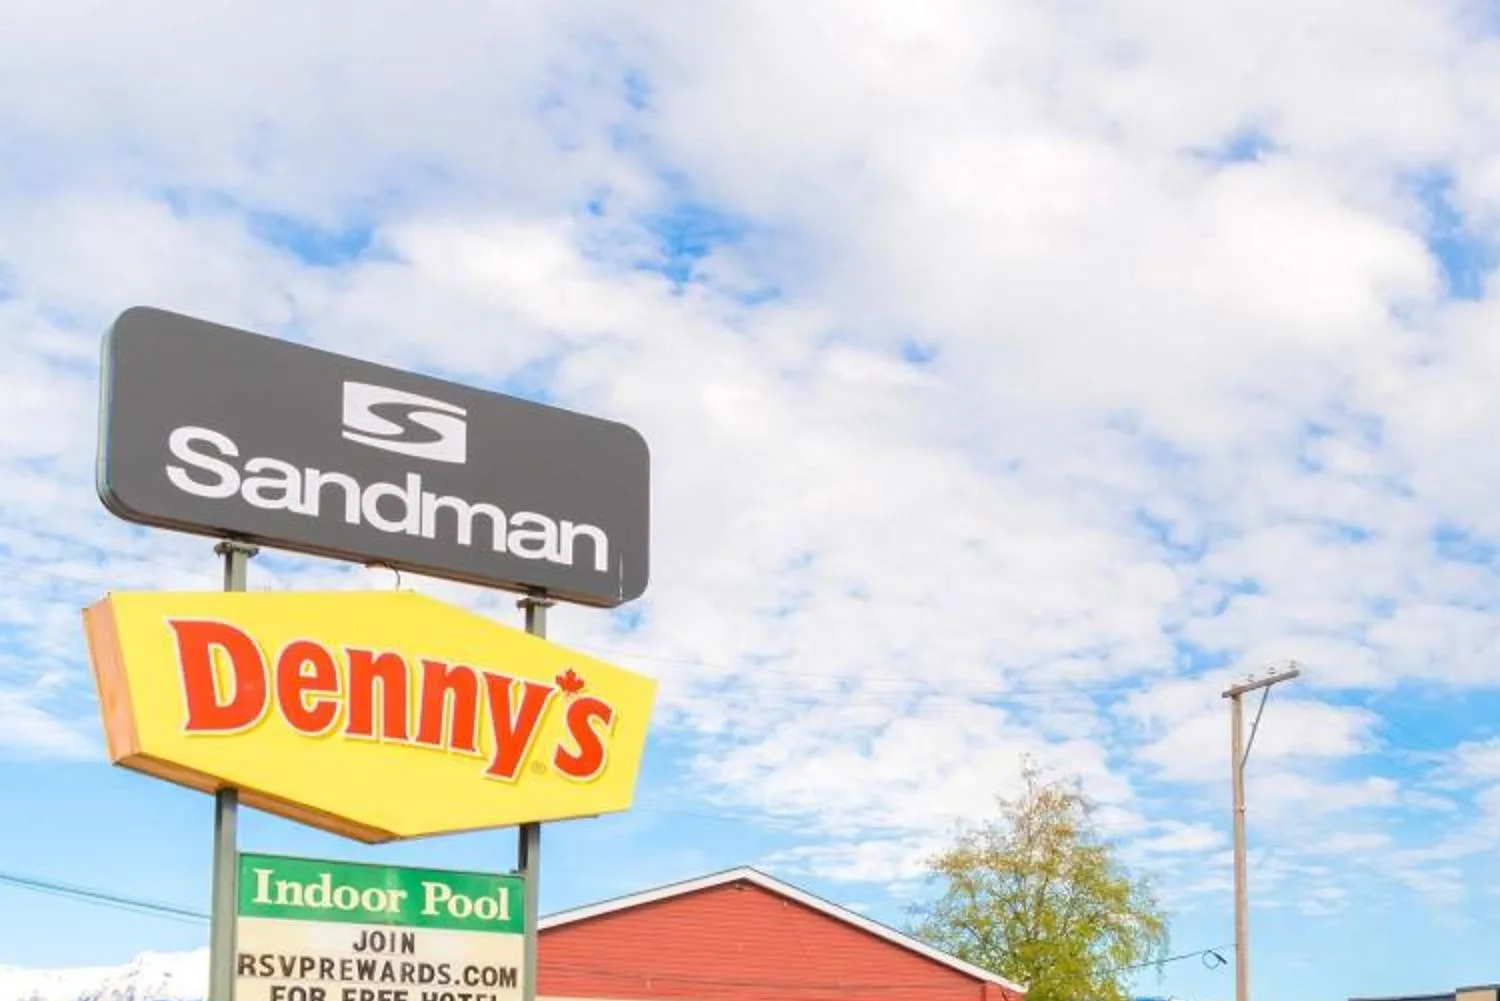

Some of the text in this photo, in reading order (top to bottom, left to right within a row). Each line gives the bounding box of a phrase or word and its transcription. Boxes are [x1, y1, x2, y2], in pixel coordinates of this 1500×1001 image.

[166, 425, 609, 571] Sandman
[165, 616, 614, 782] Denny's
[253, 867, 511, 922] Indoor Pool
[352, 930, 415, 955] JOIN
[237, 953, 518, 989] RSVPREWARDS.COM
